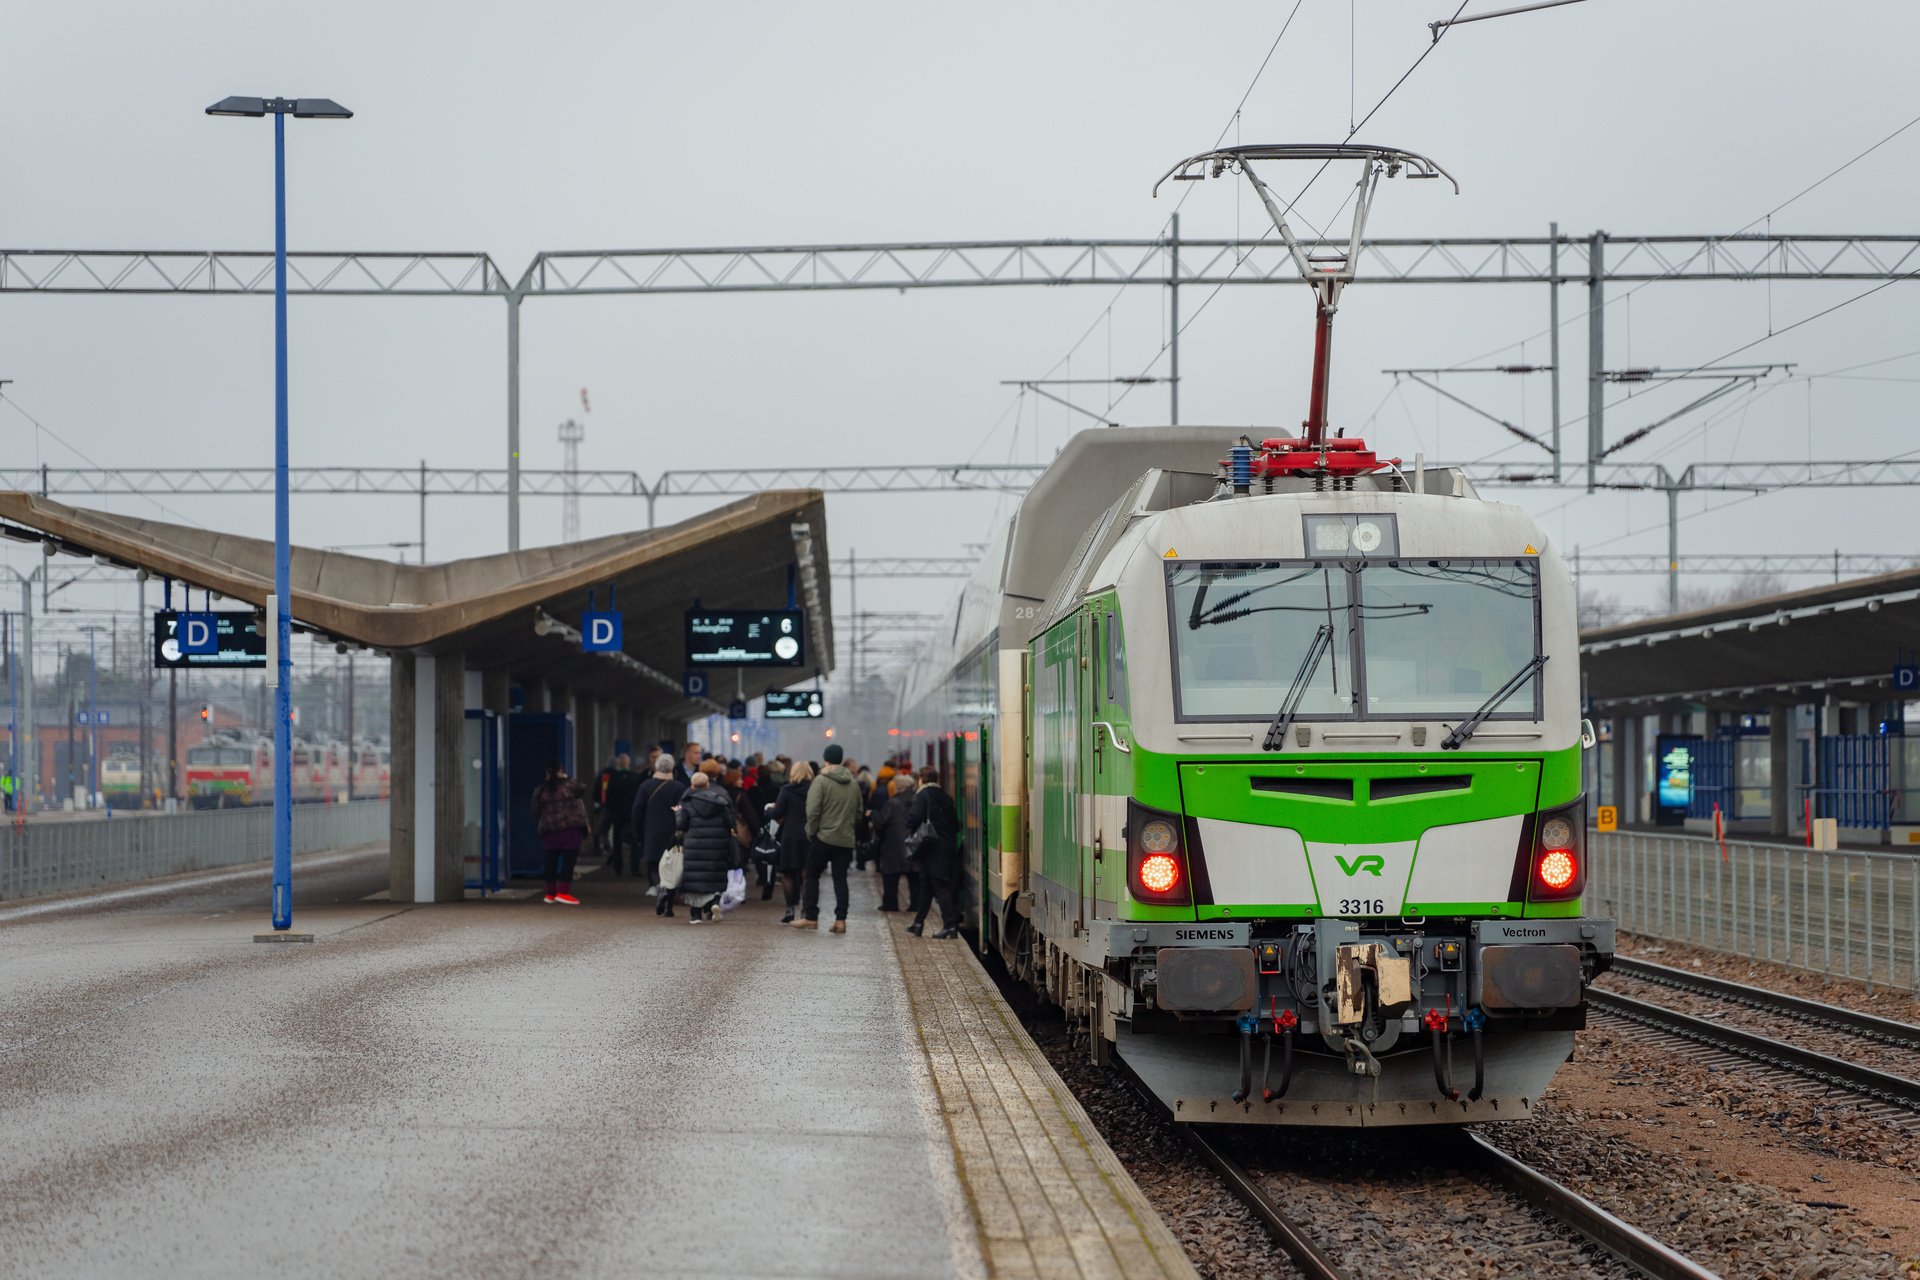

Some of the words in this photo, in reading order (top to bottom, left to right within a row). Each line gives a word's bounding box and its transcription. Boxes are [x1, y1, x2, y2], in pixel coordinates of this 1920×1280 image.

[167, 620, 178, 635] 7
[188, 621, 209, 647] D
[592, 618, 614, 644] D
[781, 618, 792, 634] 6
[689, 676, 703, 693] D
[1900, 669, 1913, 686] D
[1601, 809, 1614, 824] B
[1334, 855, 1385, 877] VR
[1339, 899, 1384, 915] 3316
[1175, 929, 1235, 940] SIEMENS
[1502, 927, 1546, 937] Vectron
